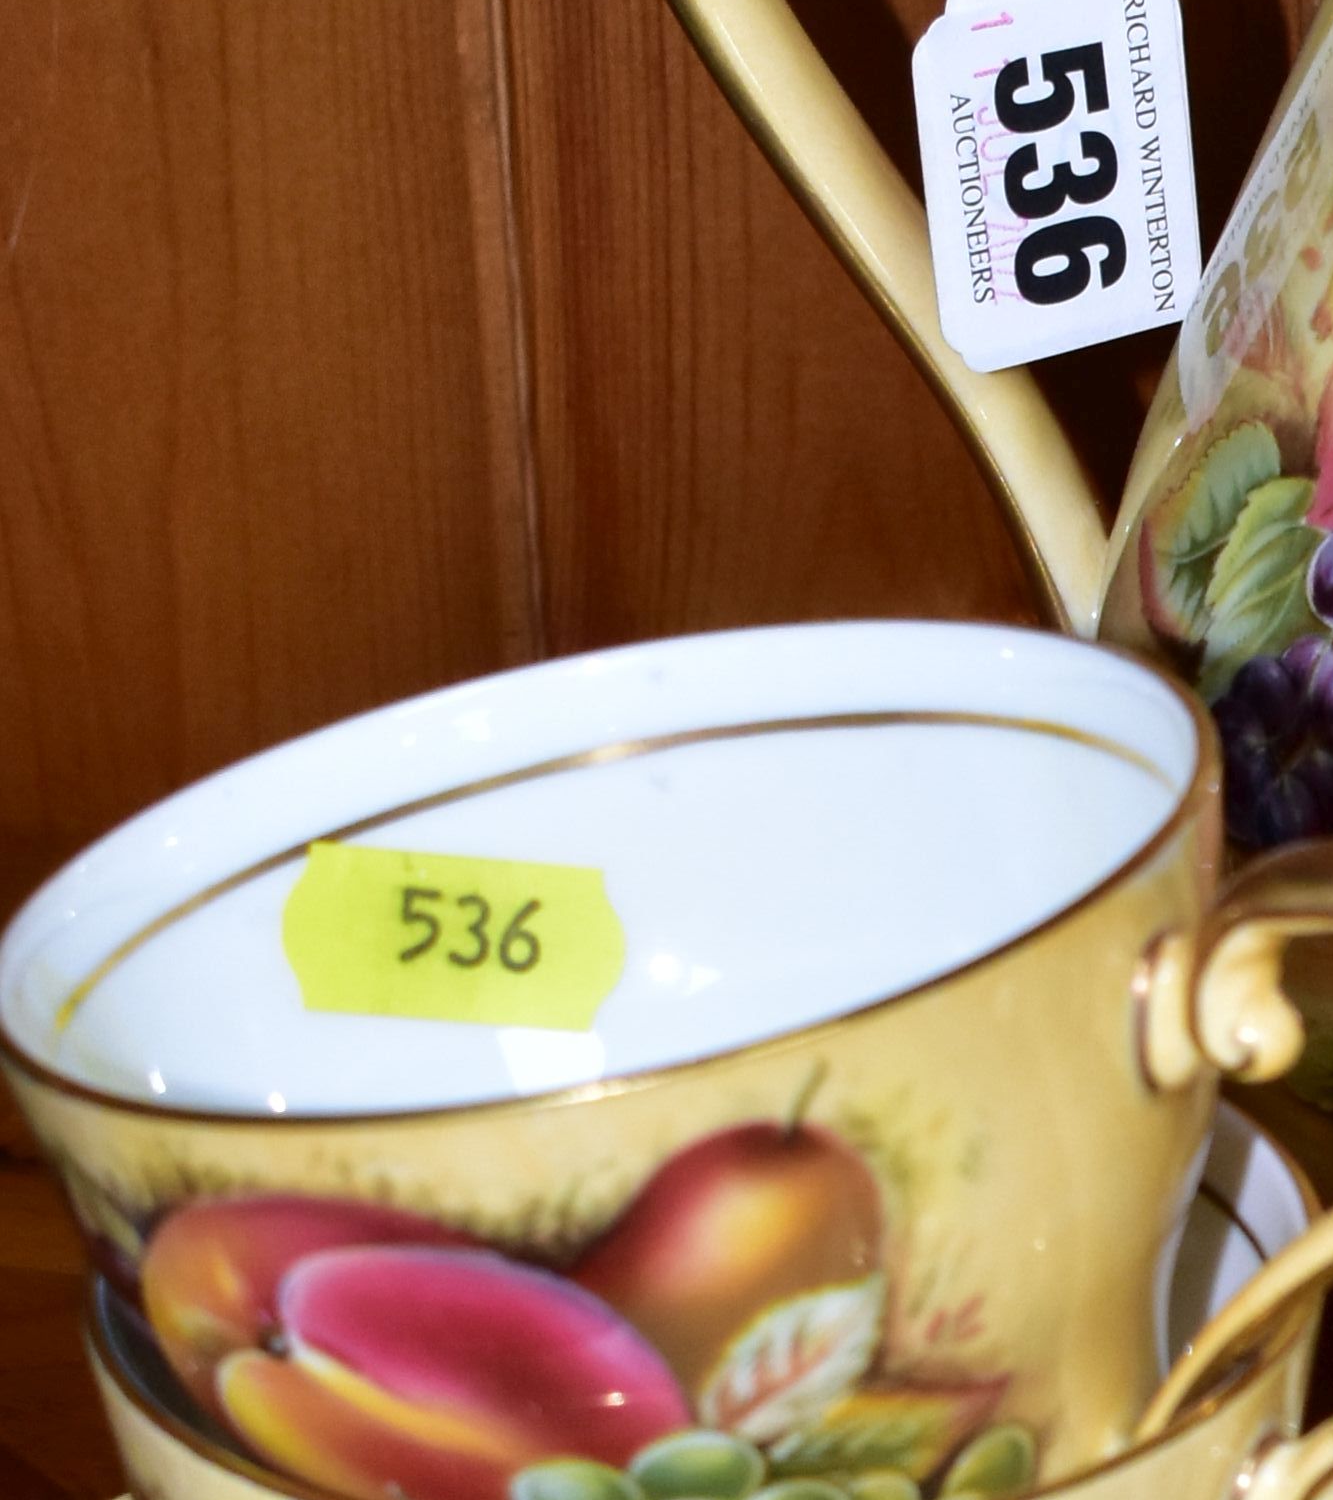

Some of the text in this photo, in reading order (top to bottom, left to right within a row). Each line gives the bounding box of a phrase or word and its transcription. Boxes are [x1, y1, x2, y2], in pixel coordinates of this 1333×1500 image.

[950, 94, 995, 304] AUCTIONEERS
[994, 42, 1127, 305] 536
[1140, 135, 1175, 311] WINTERTON
[399, 887, 542, 973] 536
